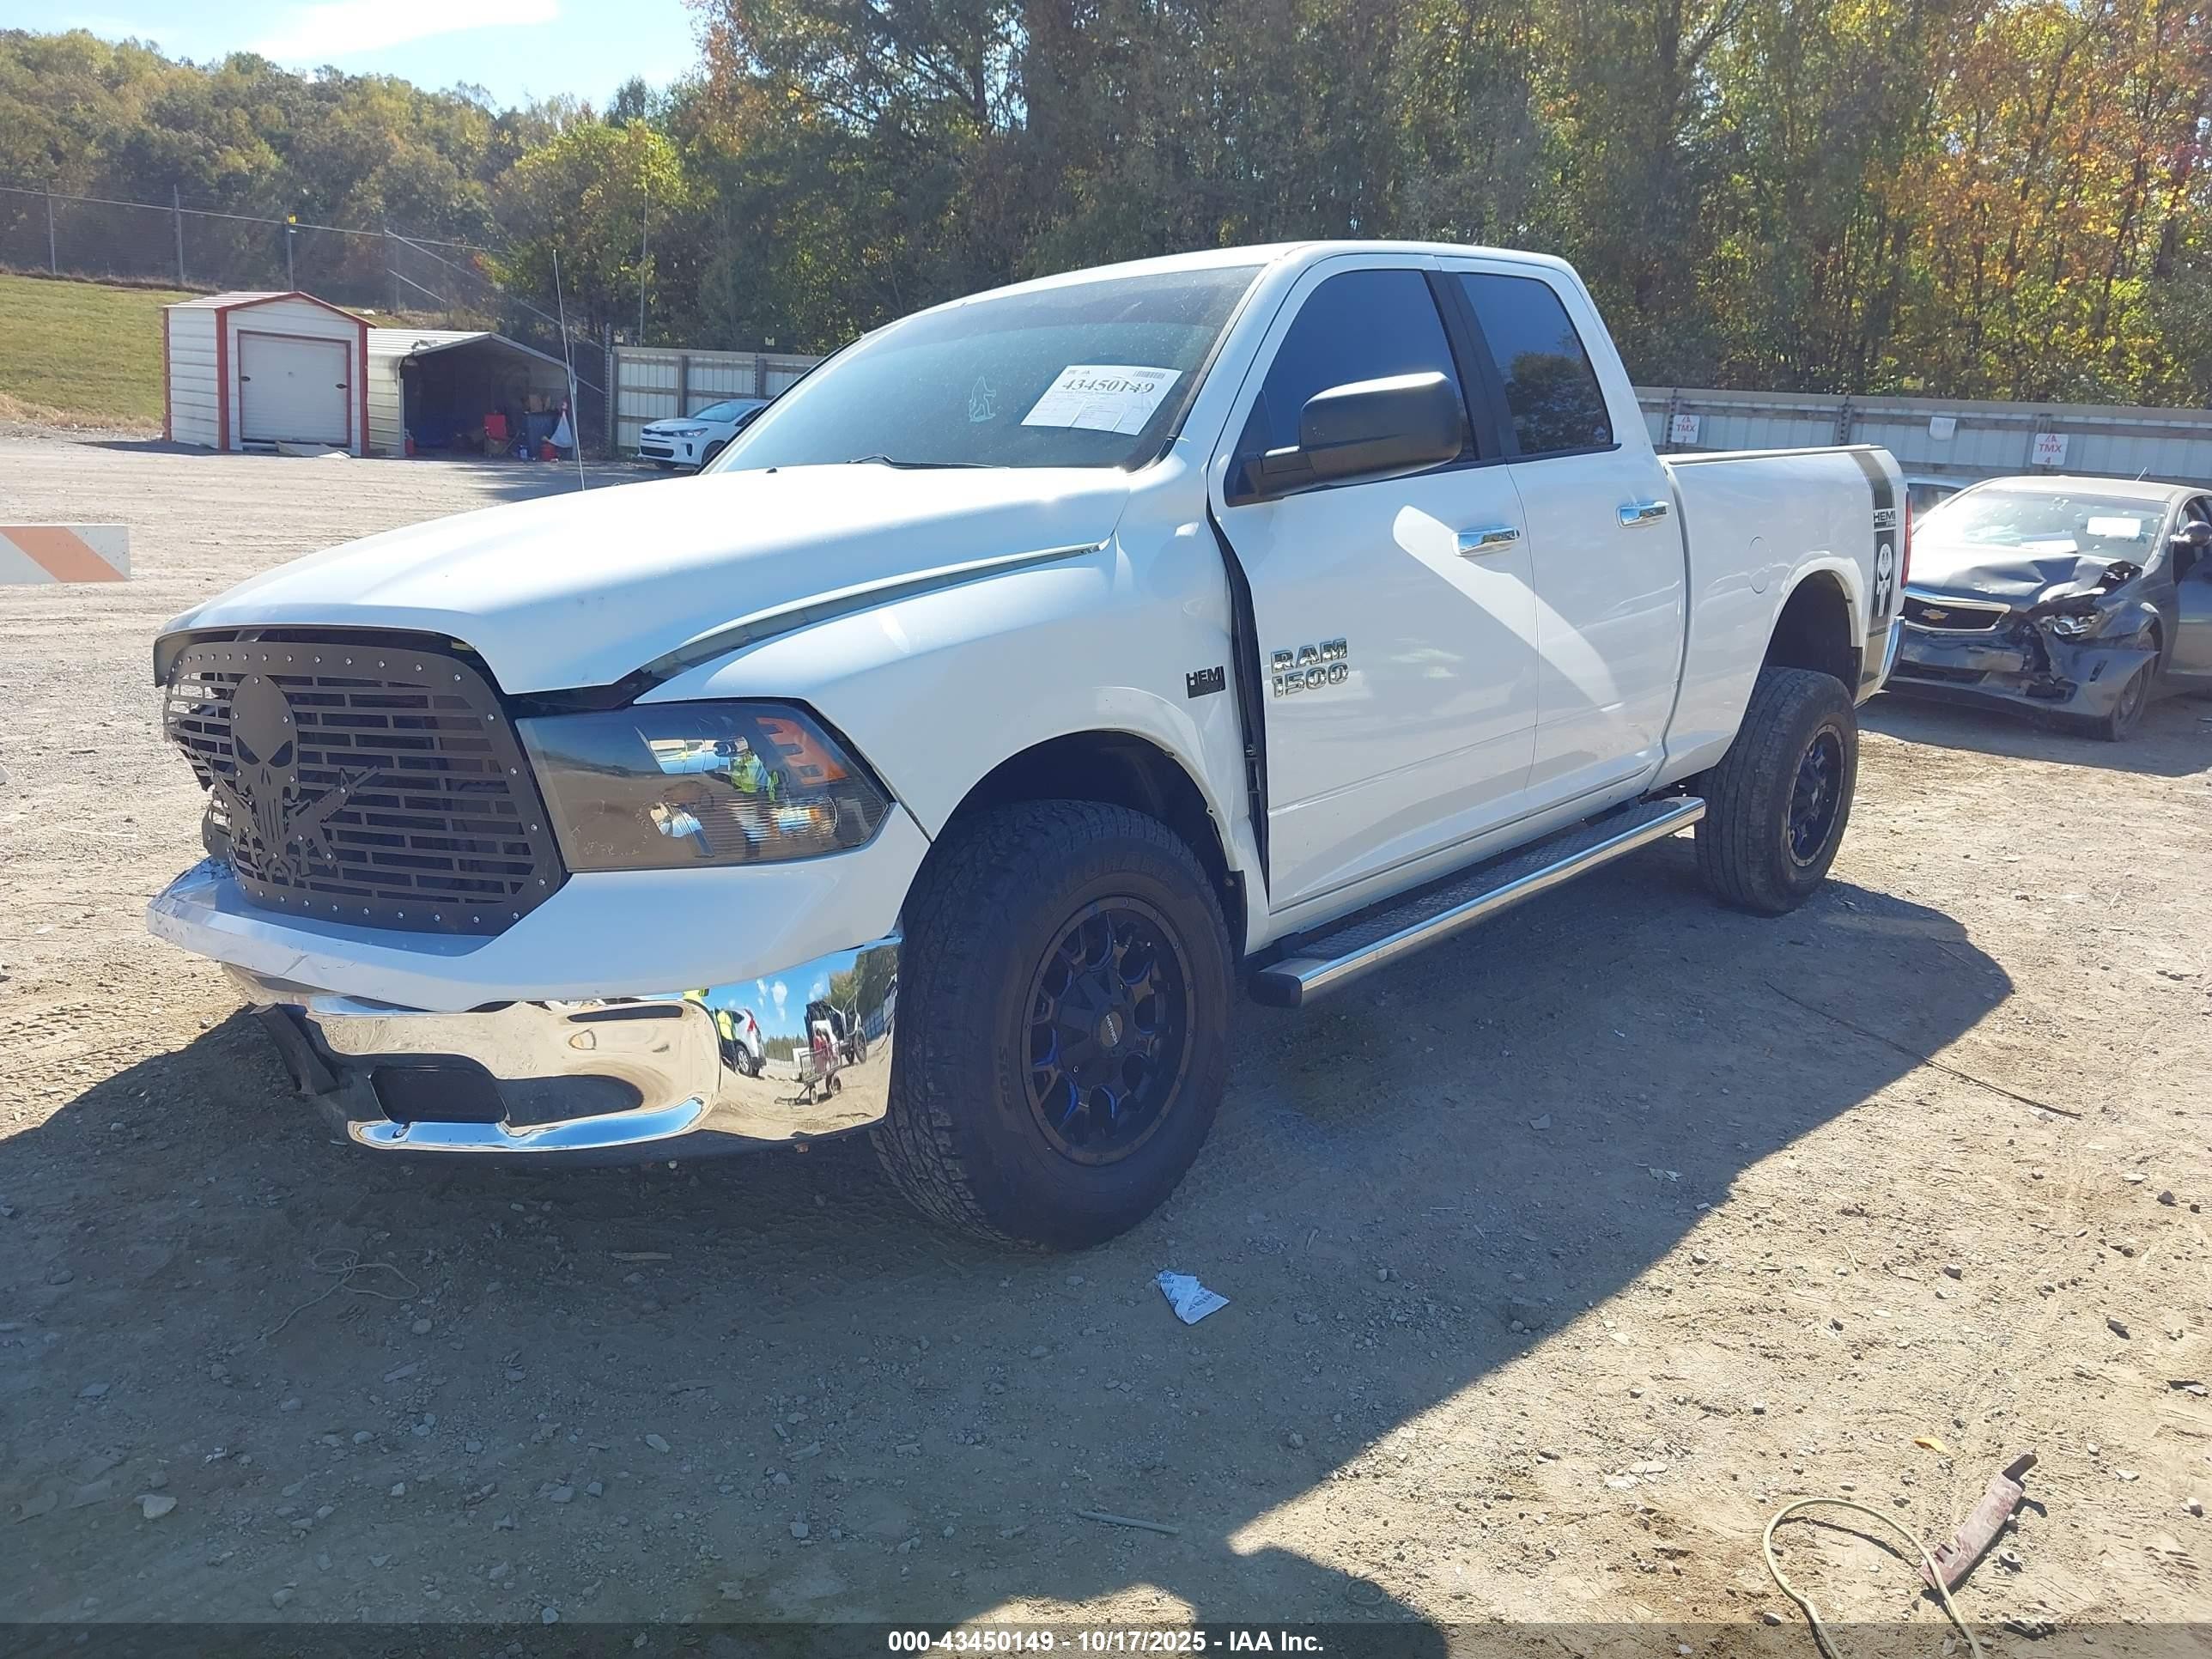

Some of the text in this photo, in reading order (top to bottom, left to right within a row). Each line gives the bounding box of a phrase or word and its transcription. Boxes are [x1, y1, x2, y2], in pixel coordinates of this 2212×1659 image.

[2039, 443, 2062, 453] TMX
[1873, 510, 1896, 522] HEMI
[1270, 637, 1347, 674] RAM
[1185, 665, 1224, 687] HEMI
[1271, 662, 1349, 698] 1500
